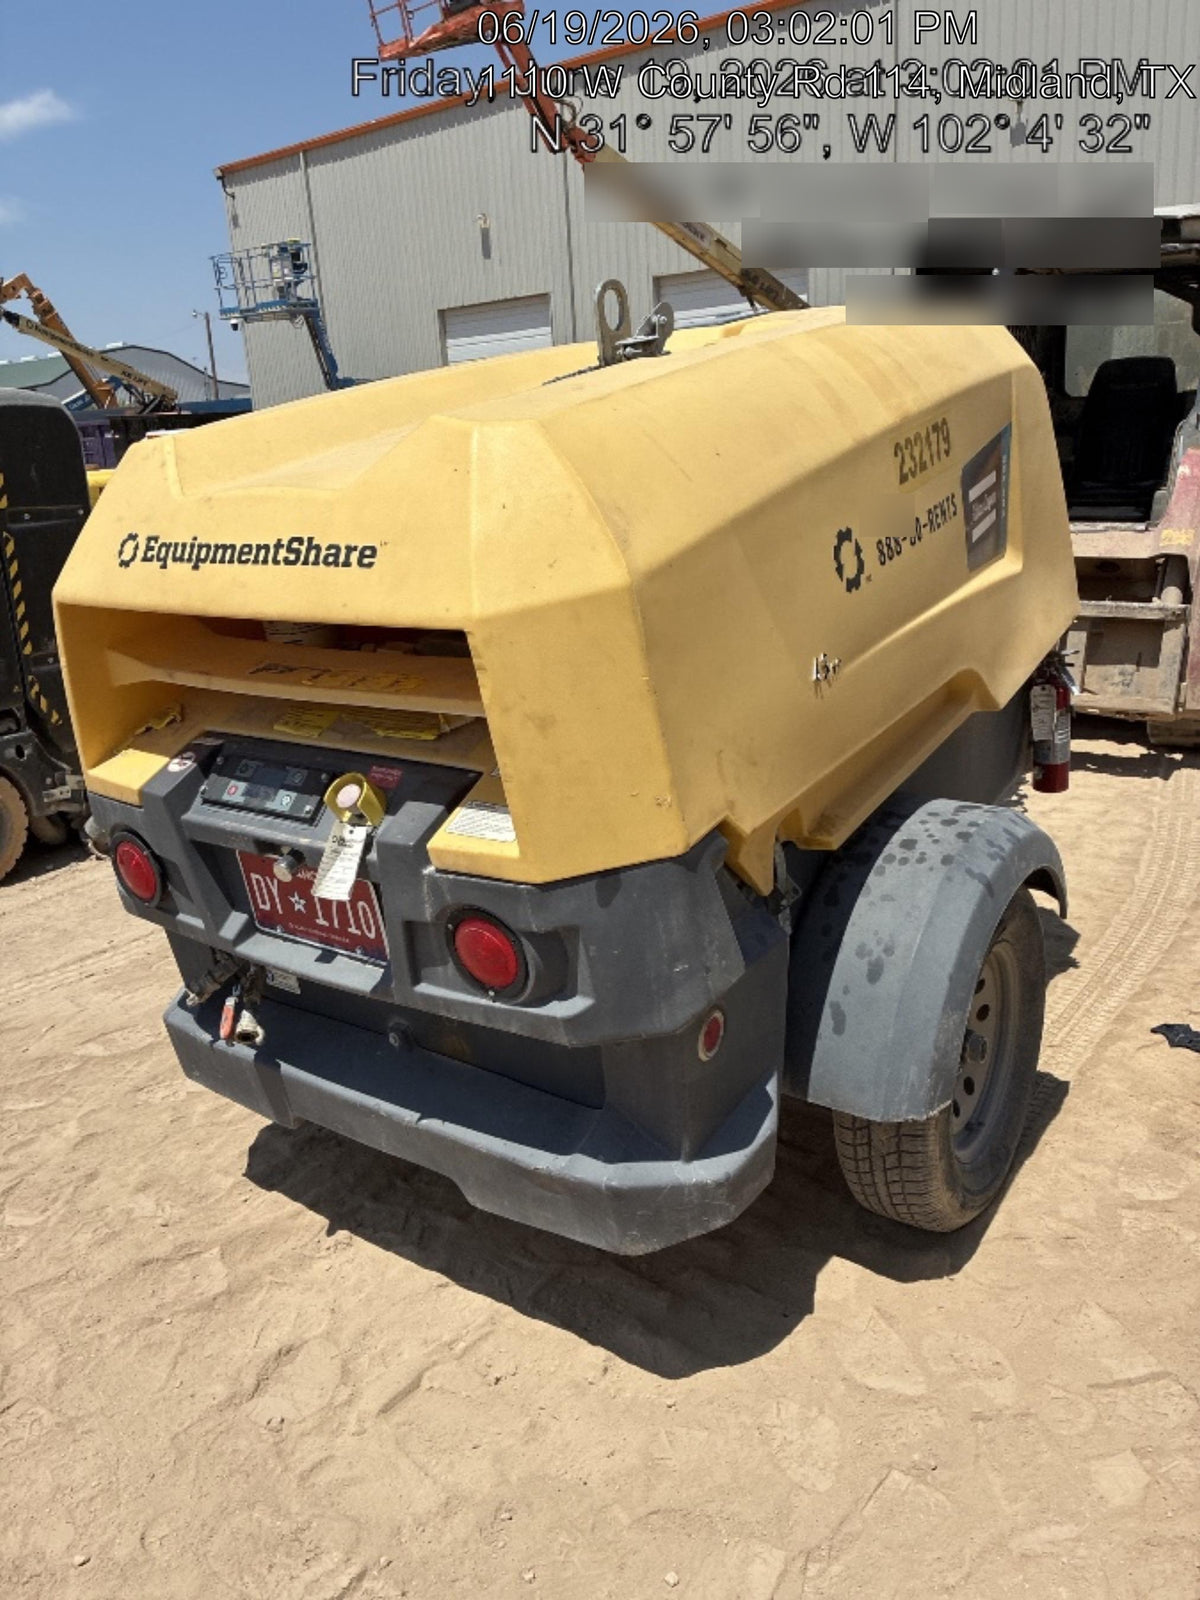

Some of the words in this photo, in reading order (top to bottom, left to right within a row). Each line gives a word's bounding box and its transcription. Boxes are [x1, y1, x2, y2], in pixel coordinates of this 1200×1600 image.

[894, 417, 951, 486] 232179
[140, 536, 378, 571] EquipmentShare
[250, 873, 284, 915] DY
